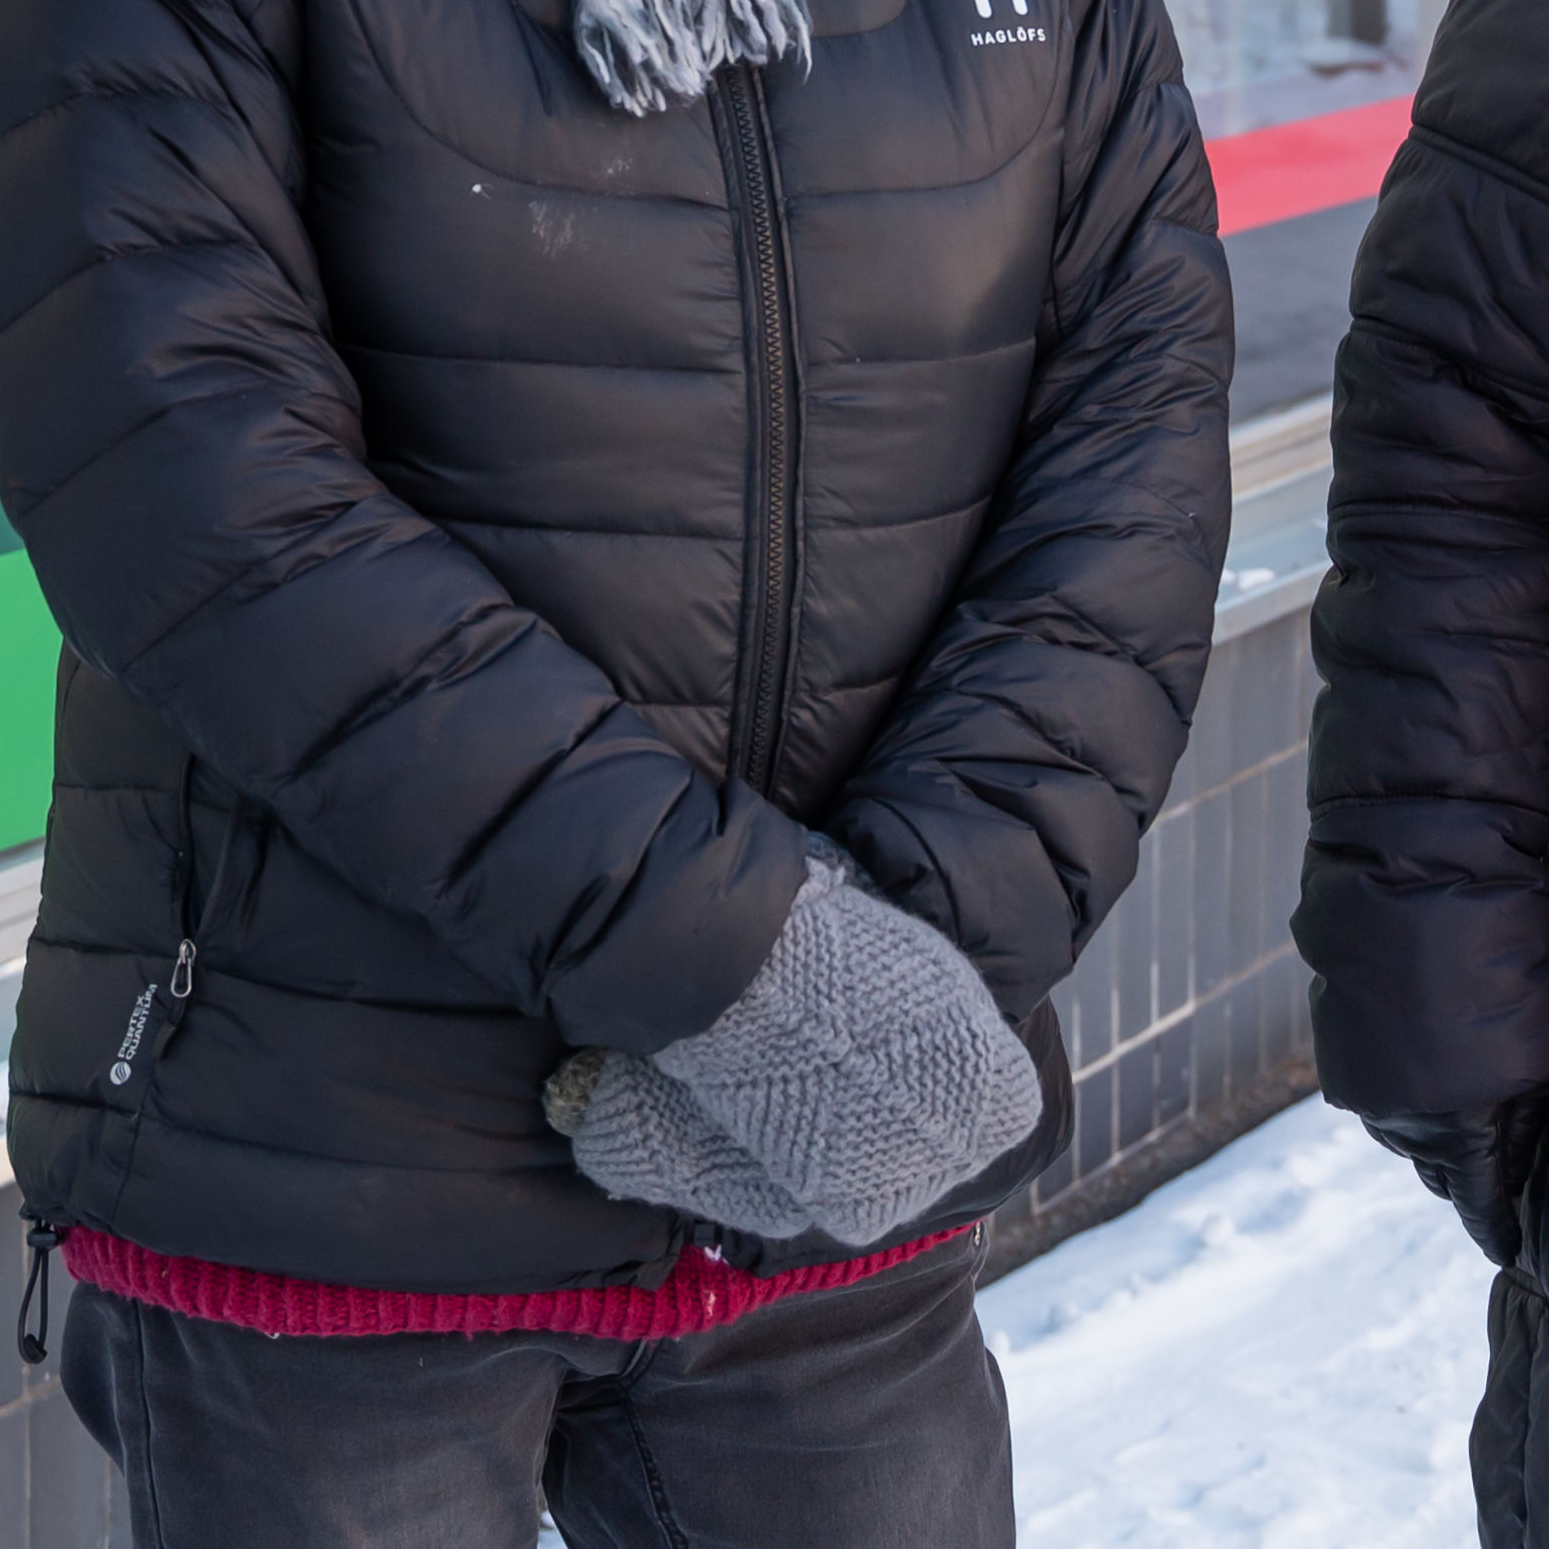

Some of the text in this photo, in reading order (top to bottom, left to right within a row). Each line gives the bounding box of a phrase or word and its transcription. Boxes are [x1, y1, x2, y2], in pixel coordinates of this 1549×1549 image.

[971, 26, 1047, 47] HAGLÖFS
[117, 995, 145, 1059] PERTEX
[125, 983, 158, 1061] QUANTUM
